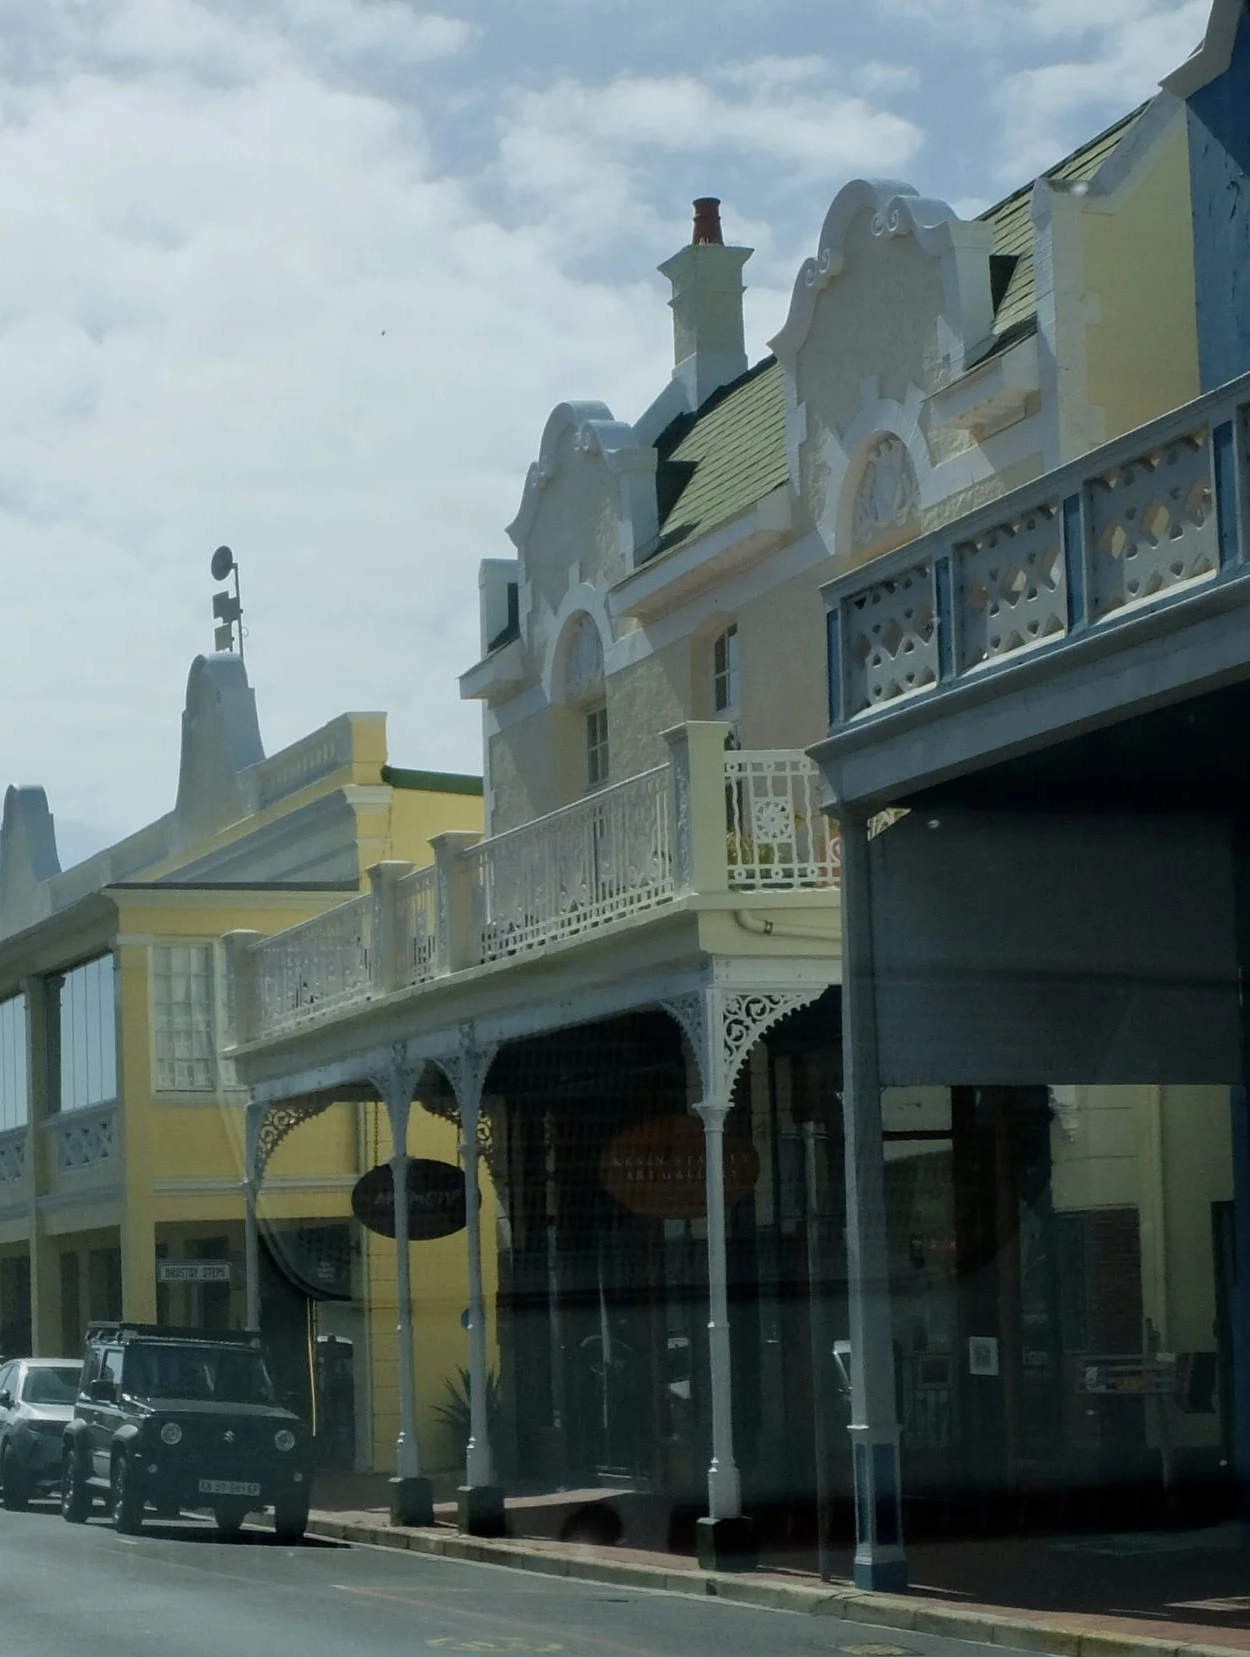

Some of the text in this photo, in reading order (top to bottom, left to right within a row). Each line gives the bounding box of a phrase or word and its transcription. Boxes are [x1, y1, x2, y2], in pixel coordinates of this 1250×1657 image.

[612, 1153, 666, 1167] KEVIN
[626, 1169, 656, 1181] ART
[204, 1266, 226, 1279] STEPS
